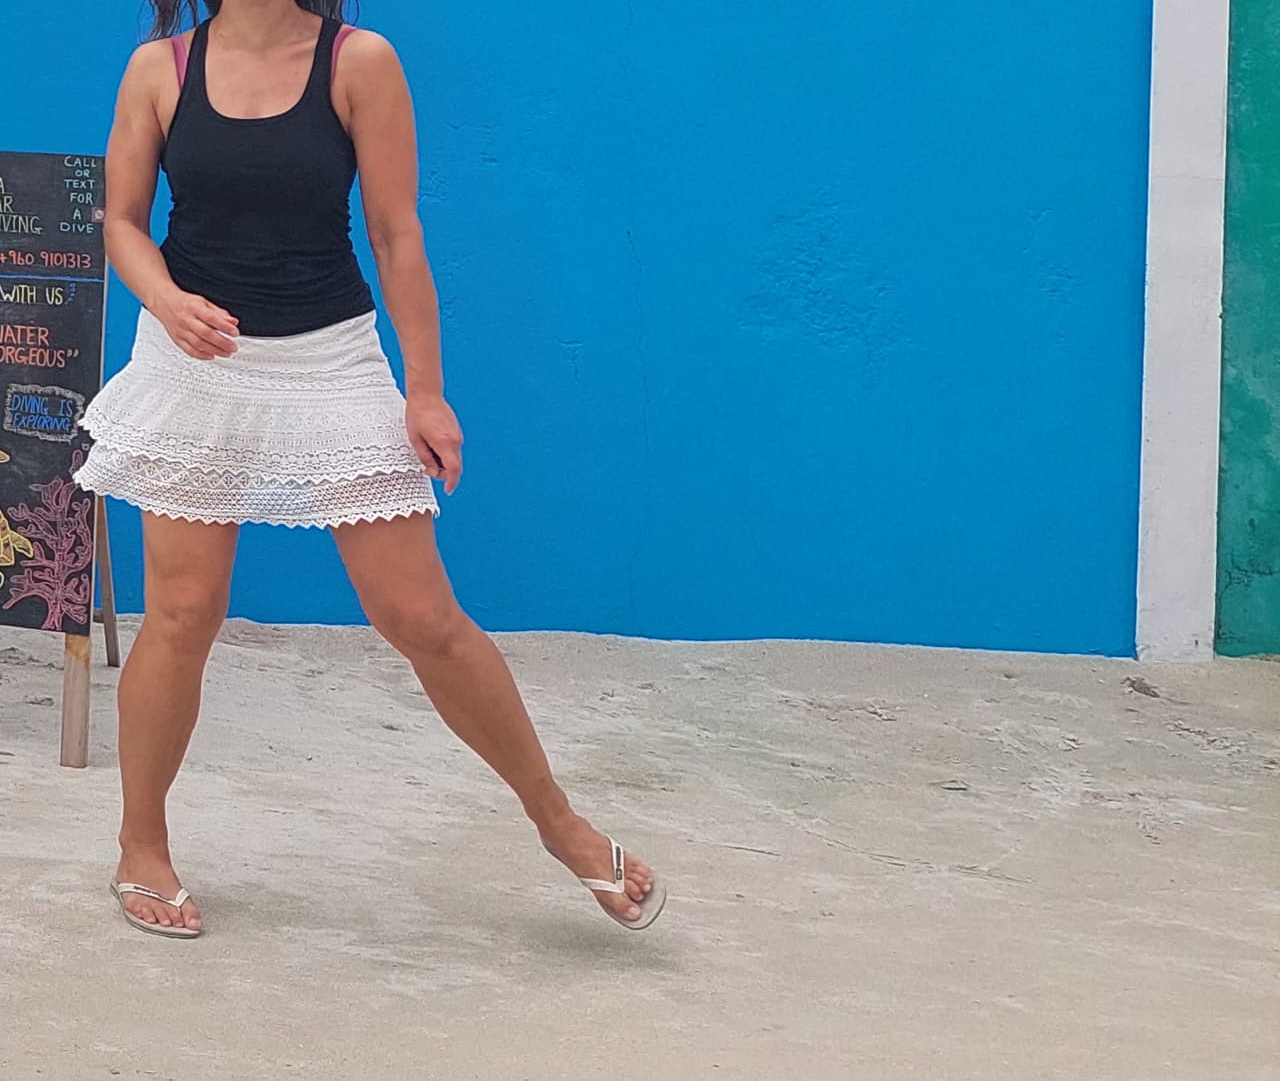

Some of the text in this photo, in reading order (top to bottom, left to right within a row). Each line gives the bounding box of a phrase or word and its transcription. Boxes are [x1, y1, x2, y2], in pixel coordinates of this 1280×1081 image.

[64, 156, 97, 168] CALL
[75, 169, 90, 178] OR
[64, 179, 96, 190] TEXT
[70, 192, 93, 205] FOR
[73, 208, 82, 220] A
[60, 222, 94, 234] DIVE
[0, 250, 92, 269] +960 9101313
[0, 283, 37, 304] WITH
[46, 287, 64, 305] US
[11, 394, 73, 417] DIVING IS
[12, 412, 71, 432] EXPLORING
